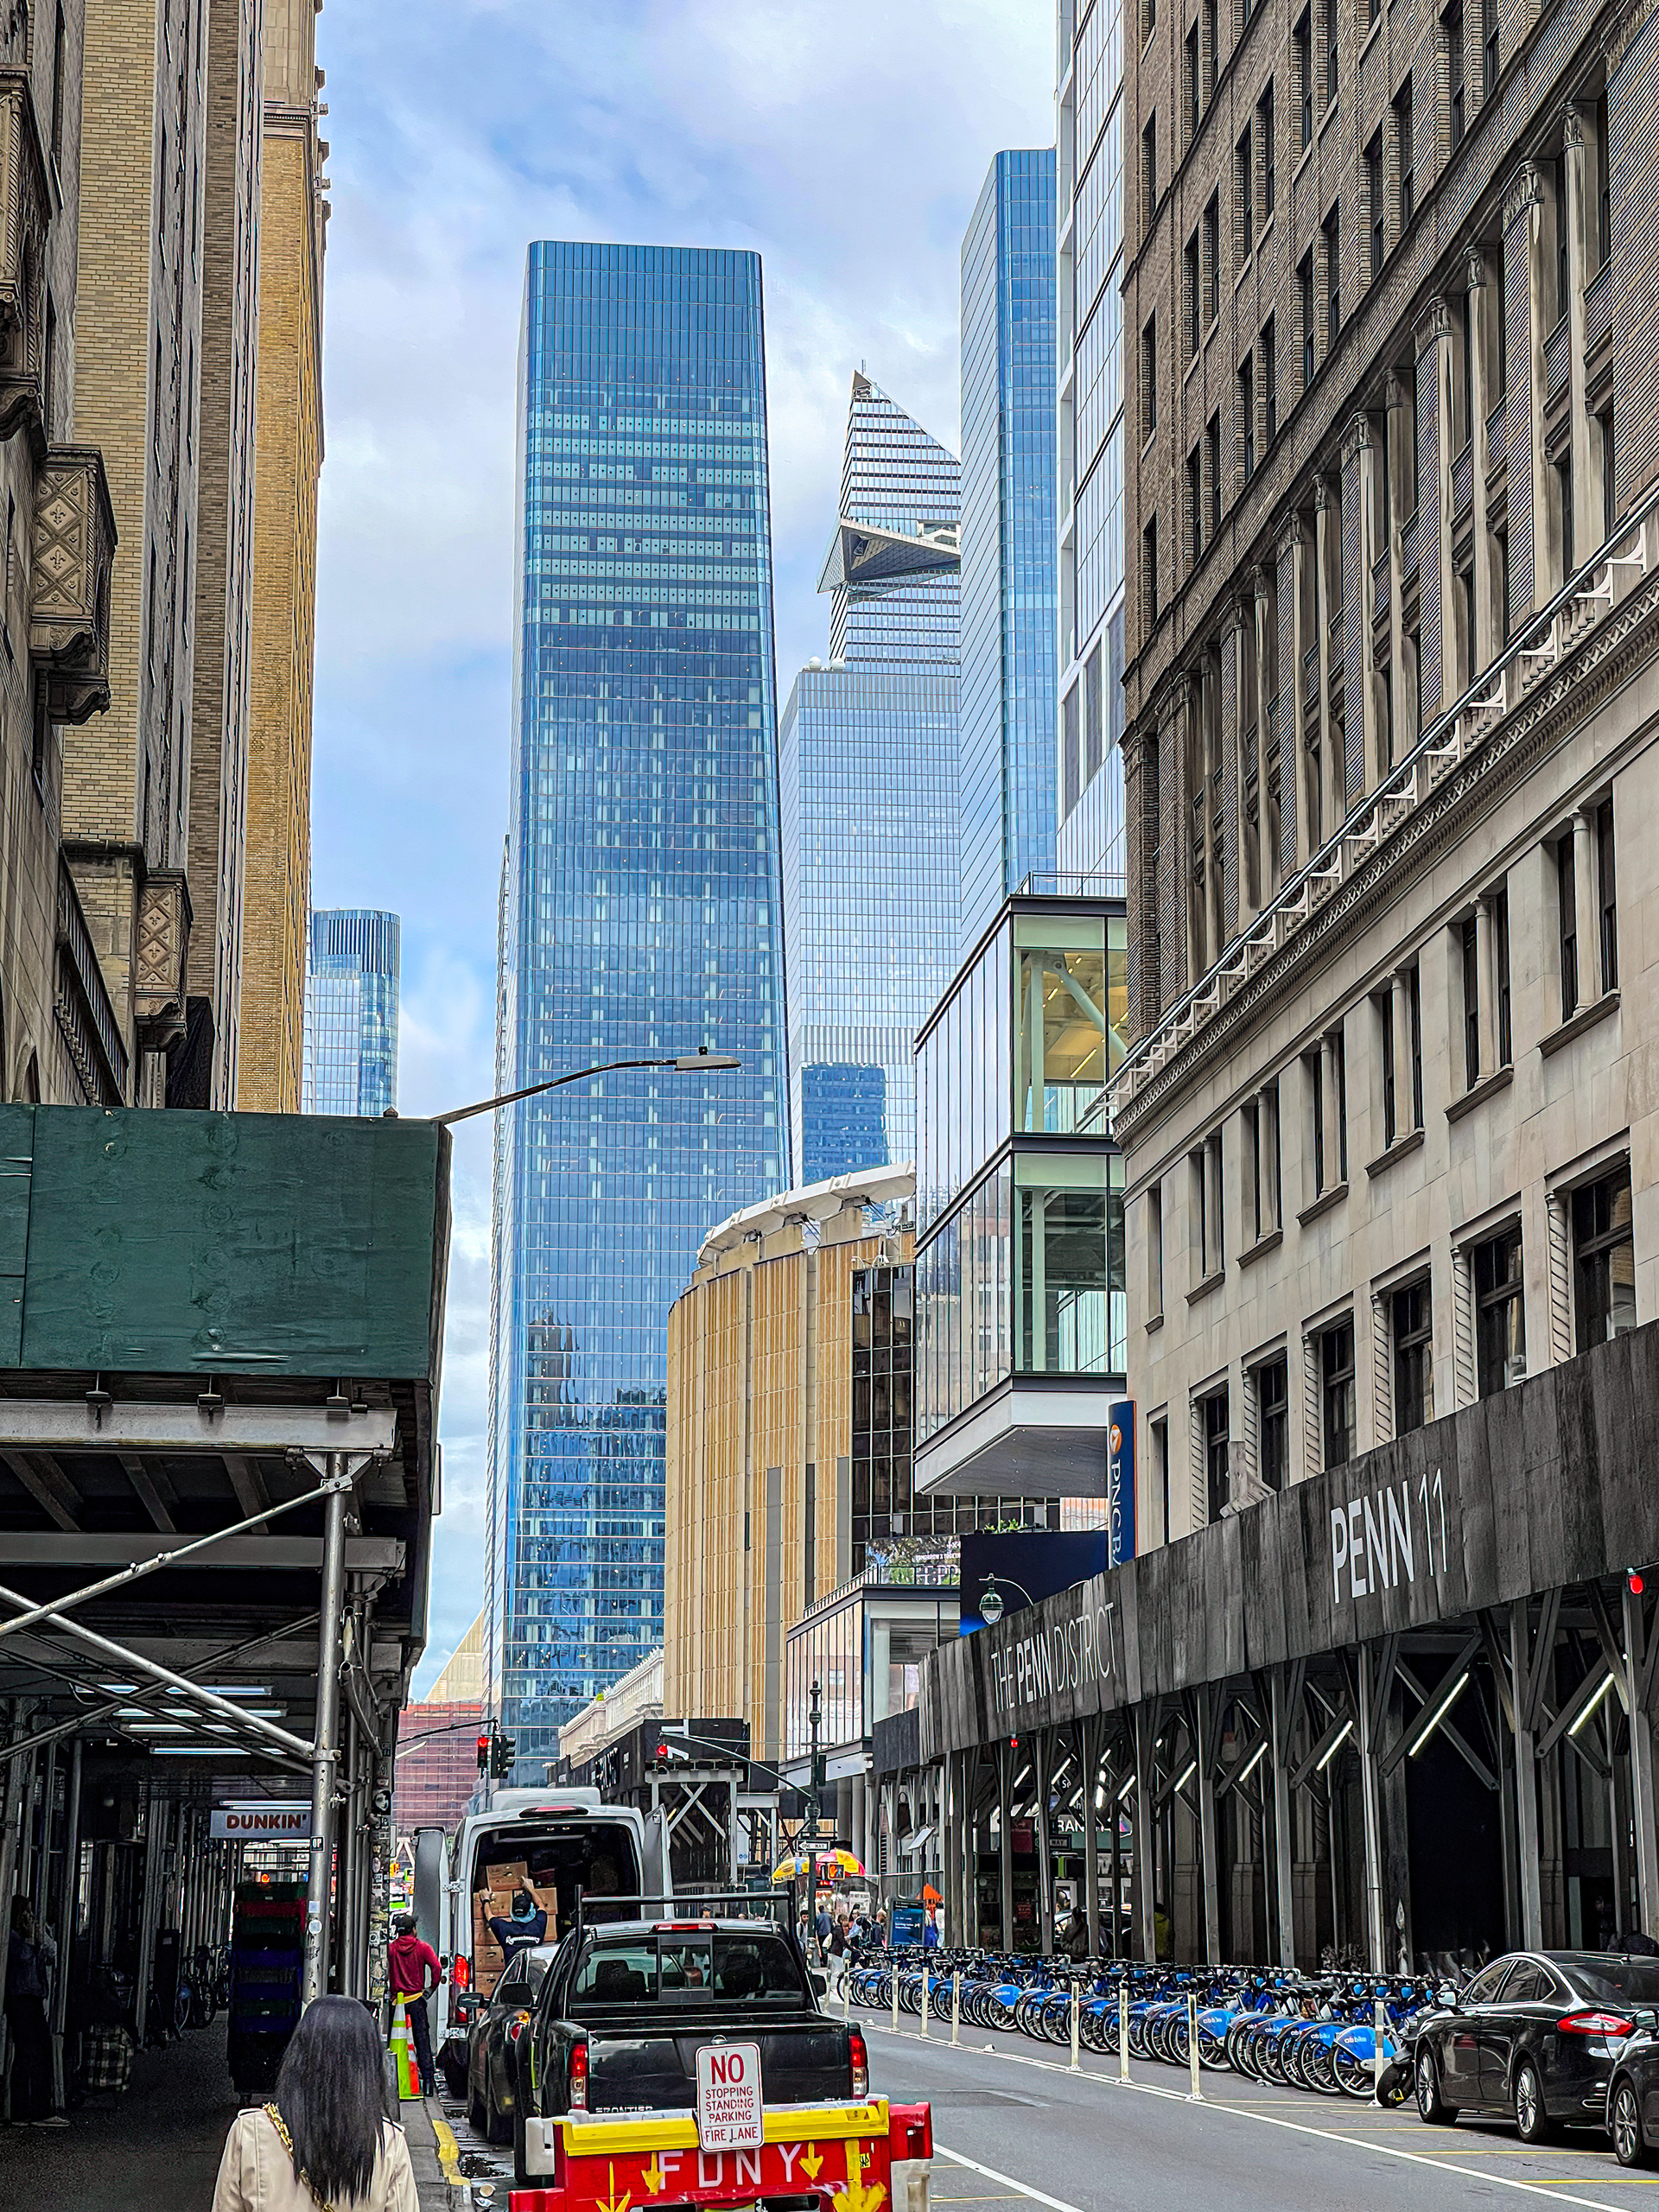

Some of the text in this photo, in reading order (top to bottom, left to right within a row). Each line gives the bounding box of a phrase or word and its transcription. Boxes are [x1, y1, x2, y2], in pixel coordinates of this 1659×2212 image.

[1111, 1459, 1122, 1529] PNC
[1331, 1468, 1447, 1604] PENN 11
[990, 1602, 1116, 1713] THE PENN DISTRICT
[226, 1815, 307, 1829] DUNKIN'
[710, 2053, 745, 2085] NO
[705, 2086, 753, 2100] STOPPING
[705, 2098, 754, 2112] STANDING
[709, 2110, 752, 2124] PARKING
[705, 2126, 759, 2143] FIRE LANE
[658, 2143, 802, 2190] FDNY
